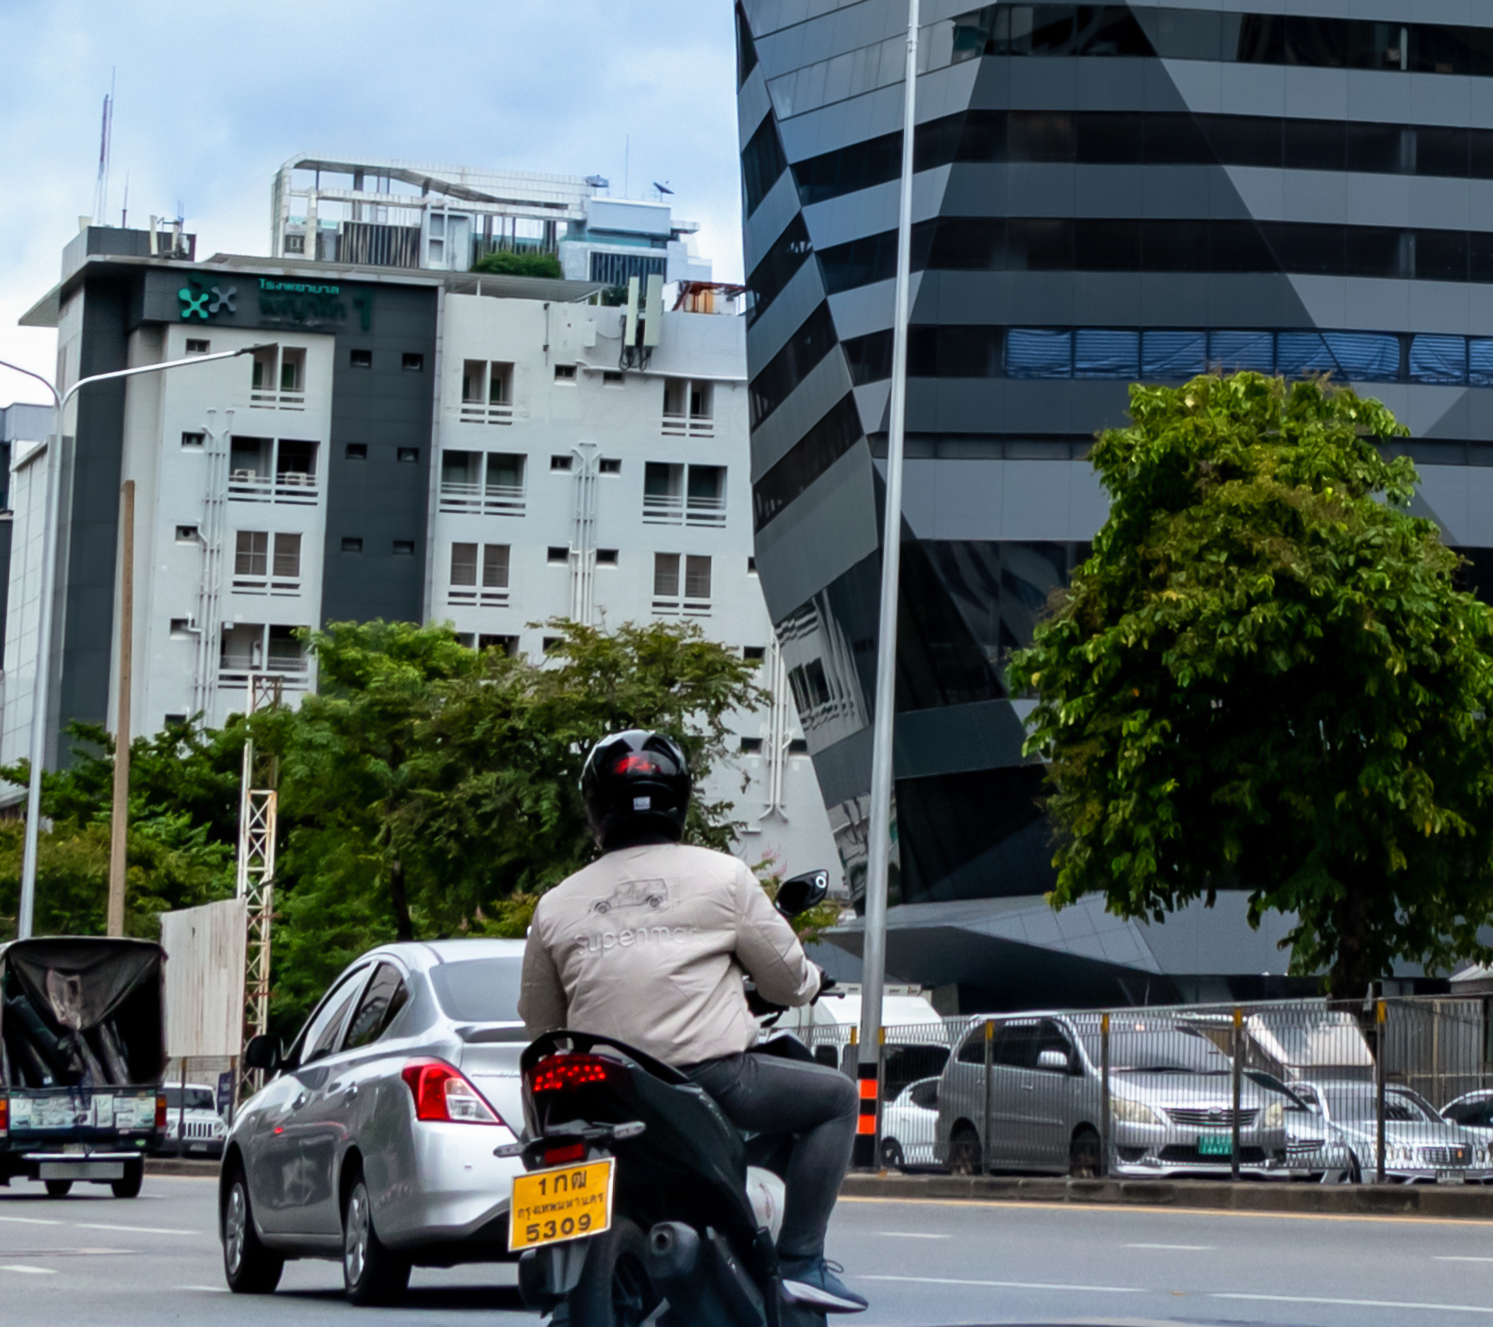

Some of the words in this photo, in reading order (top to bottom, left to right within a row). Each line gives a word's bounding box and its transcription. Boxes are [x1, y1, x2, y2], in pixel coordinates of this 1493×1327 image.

[259, 277, 340, 295] โรงพยาบาล
[525, 1213, 592, 1242] 5309
